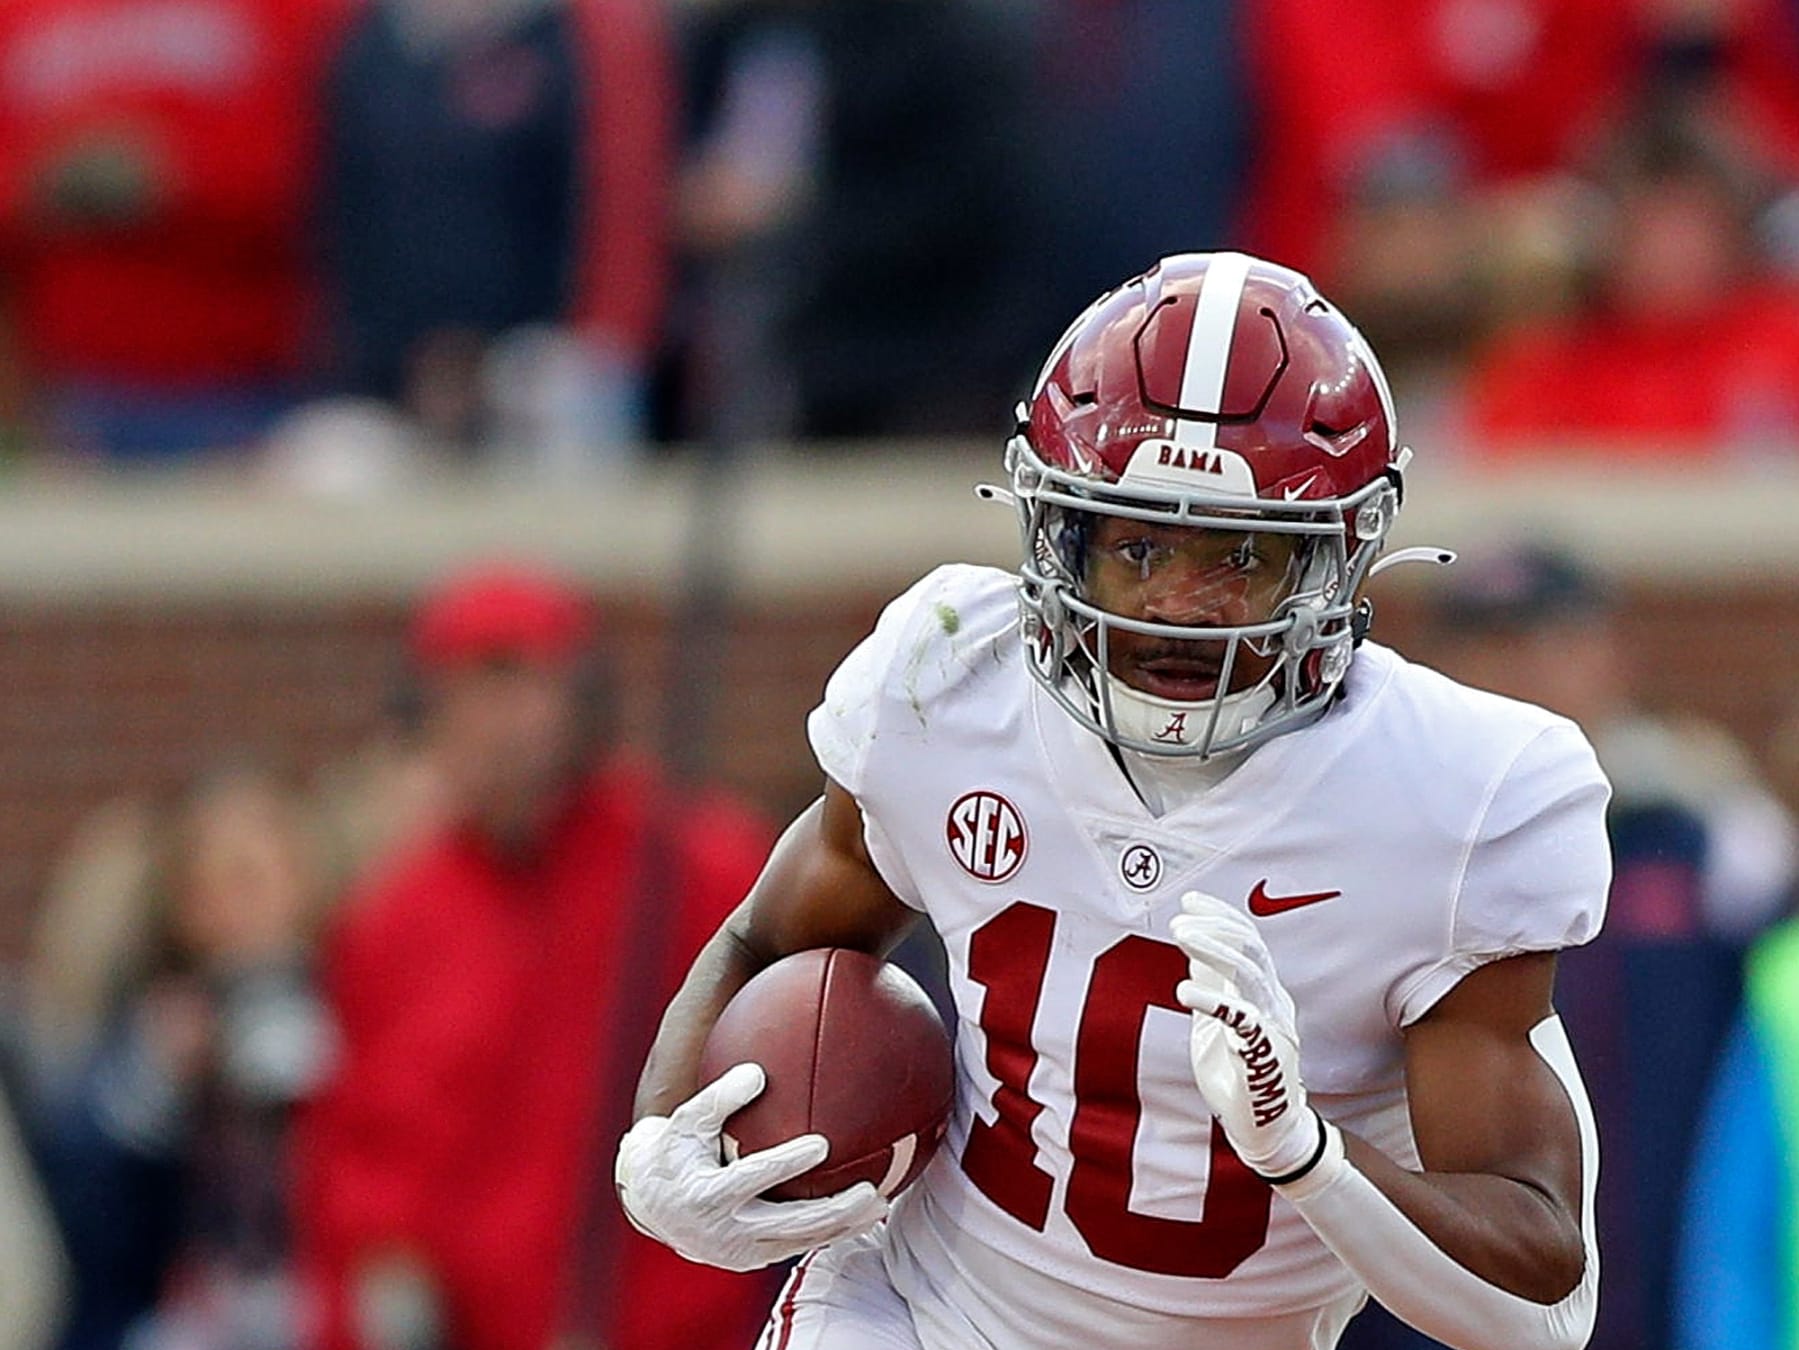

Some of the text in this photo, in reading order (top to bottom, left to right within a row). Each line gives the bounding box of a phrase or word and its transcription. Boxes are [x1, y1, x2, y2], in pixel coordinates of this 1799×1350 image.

[1158, 445, 1222, 475] BAMA
[1154, 712, 1188, 744] A
[951, 795, 1020, 877] SEC
[1126, 852, 1151, 879] A
[961, 901, 1274, 1278] 10
